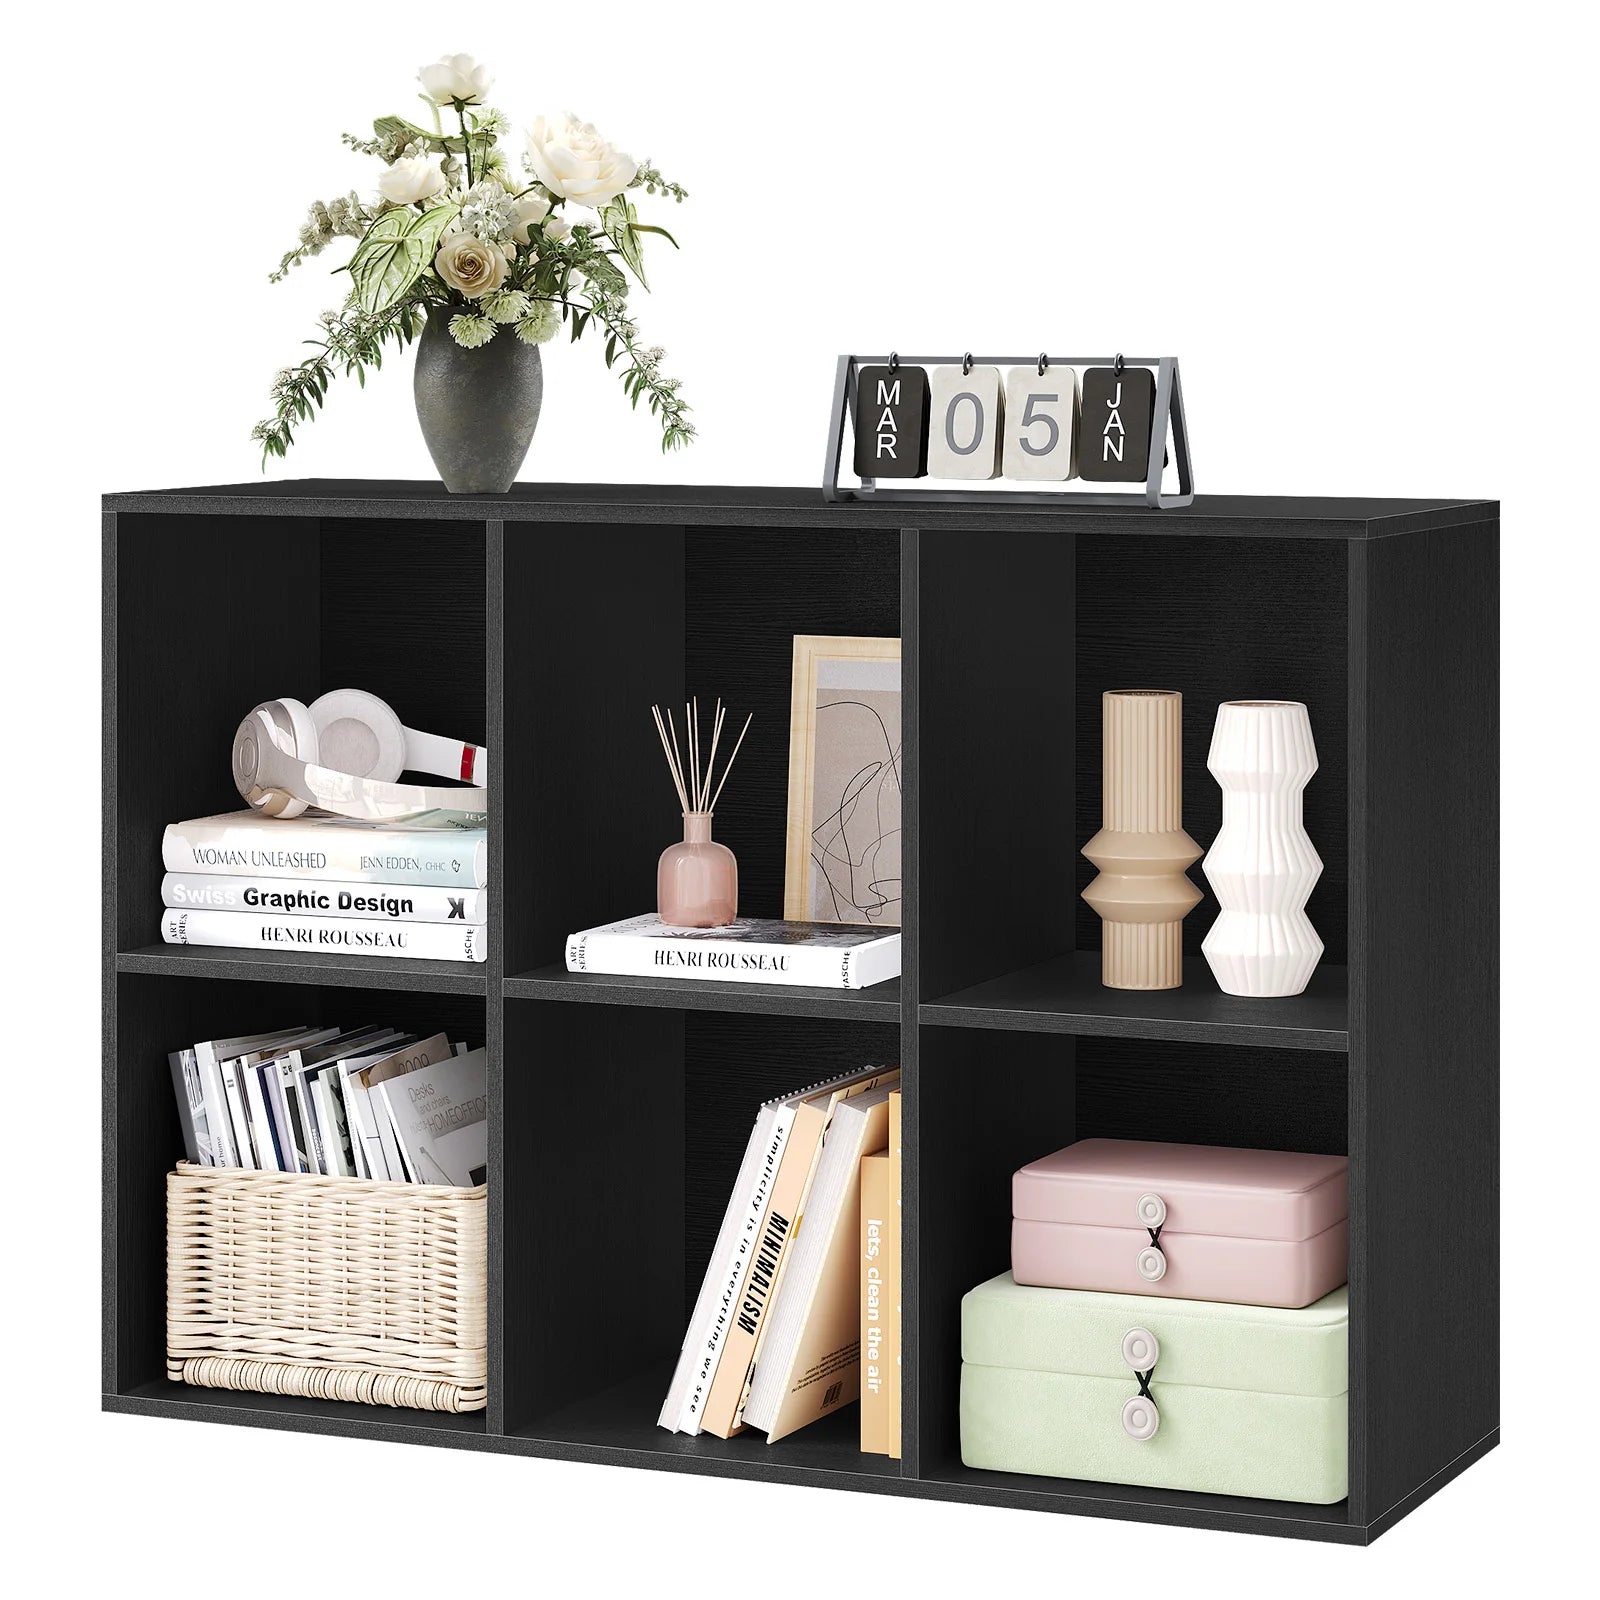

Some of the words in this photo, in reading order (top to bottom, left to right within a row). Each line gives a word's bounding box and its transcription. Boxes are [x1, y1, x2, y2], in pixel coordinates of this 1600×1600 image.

[875, 379, 899, 459] MAR
[1102, 382, 1126, 462] JAN
[192, 848, 248, 866] WOMAN
[251, 850, 327, 869] UNLEASHED
[360, 855, 384, 870] JENN
[386, 856, 422, 872] EDDEN,
[172, 884, 236, 906] Swiss
[243, 887, 330, 912] Graphic
[338, 891, 414, 917] Design
[170, 921, 179, 939] ART
[261, 926, 313, 944] HENRI
[319, 929, 408, 949] ROUSSEAU
[570, 944, 578, 964] ART
[579, 935, 588, 970] SERIES
[654, 950, 703, 967] HENRI
[707, 952, 791, 971] ROUSSEAU
[407, 1083, 435, 1103] Desks
[752, 1125, 784, 1211] simplicity
[746, 1217, 757, 1231] is
[739, 1238, 750, 1254] in
[865, 1219, 883, 1261] lets,
[737, 1211, 789, 1336] MINIMALISM
[707, 1261, 742, 1351] everything
[867, 1267, 883, 1321] clean
[867, 1327, 883, 1361] the
[700, 1357, 711, 1379] we
[867, 1365, 882, 1394] air
[690, 1385, 703, 1413] see
